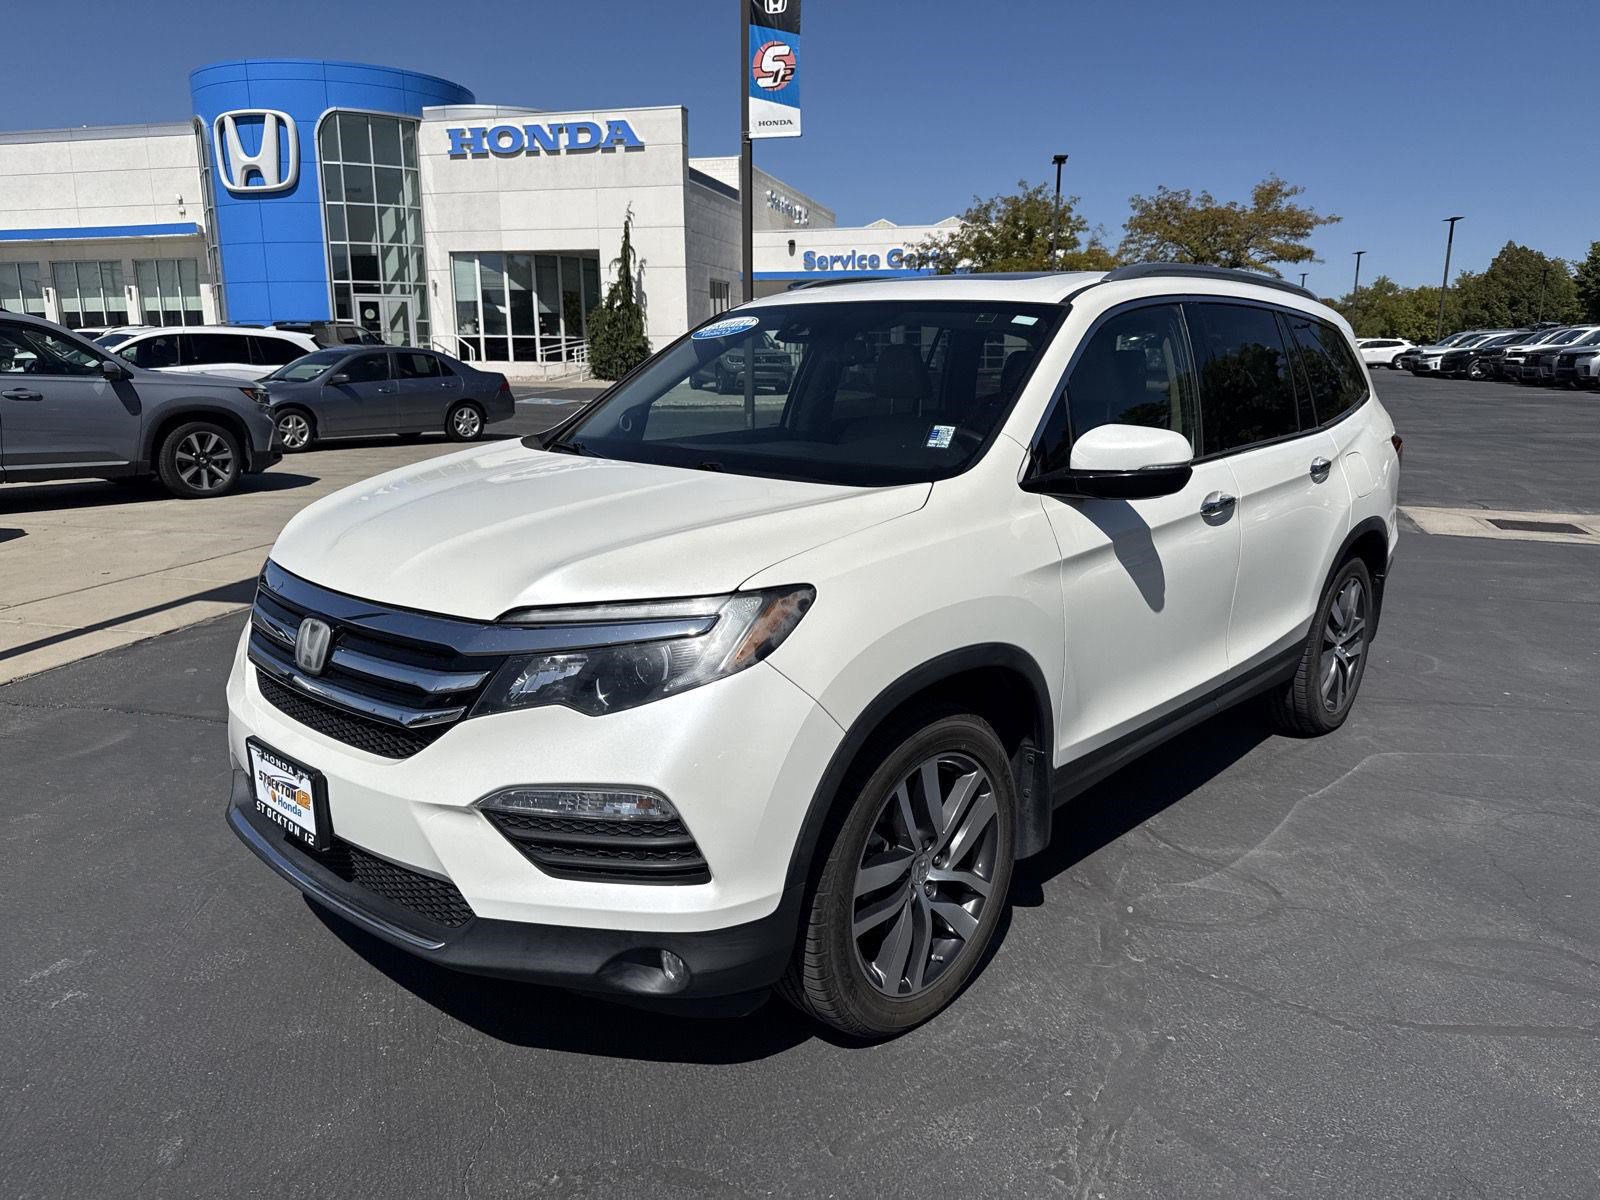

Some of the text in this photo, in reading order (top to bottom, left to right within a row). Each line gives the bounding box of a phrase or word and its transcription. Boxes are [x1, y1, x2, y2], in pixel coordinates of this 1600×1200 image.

[758, 119, 793, 127] HONDA
[446, 119, 645, 159] HONDA
[803, 249, 881, 271] Service
[263, 752, 294, 775] HONDA
[258, 770, 312, 811] STOCKTON 12
[277, 794, 302, 818] Honda
[256, 800, 315, 846] STOCKTON 12
